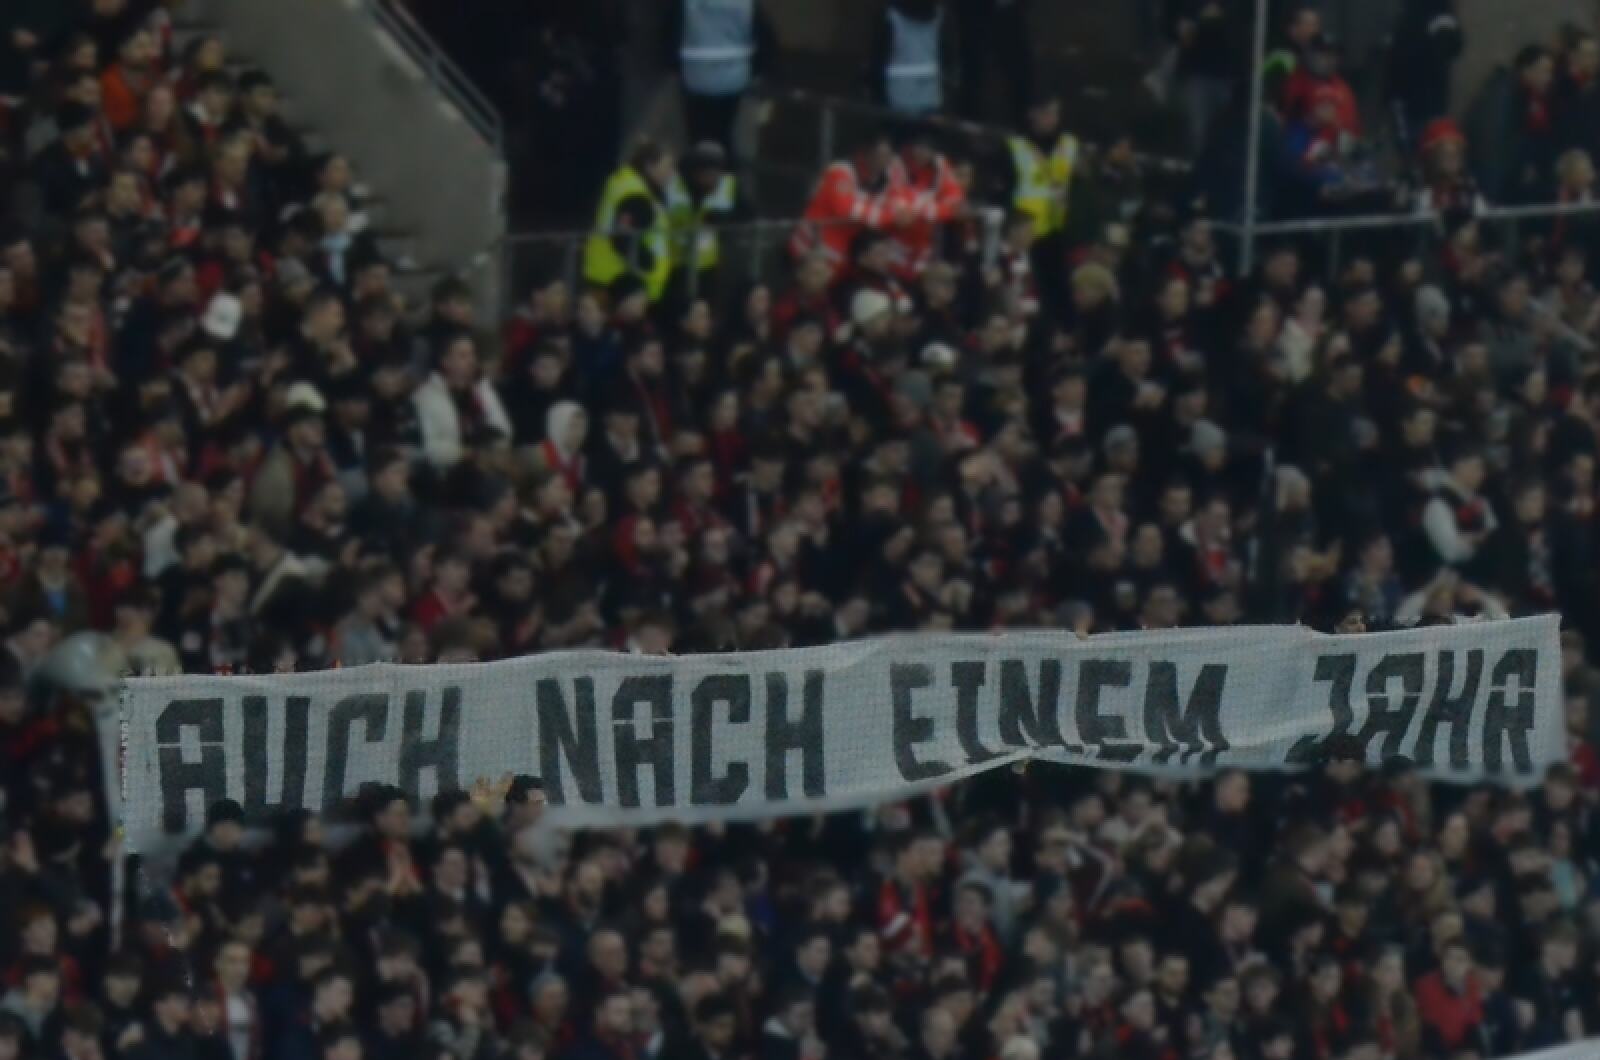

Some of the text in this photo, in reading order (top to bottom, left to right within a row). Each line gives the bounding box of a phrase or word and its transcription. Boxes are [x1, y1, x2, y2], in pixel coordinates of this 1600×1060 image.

[156, 647, 1538, 834] AUCH NACH EINEM JAHR
